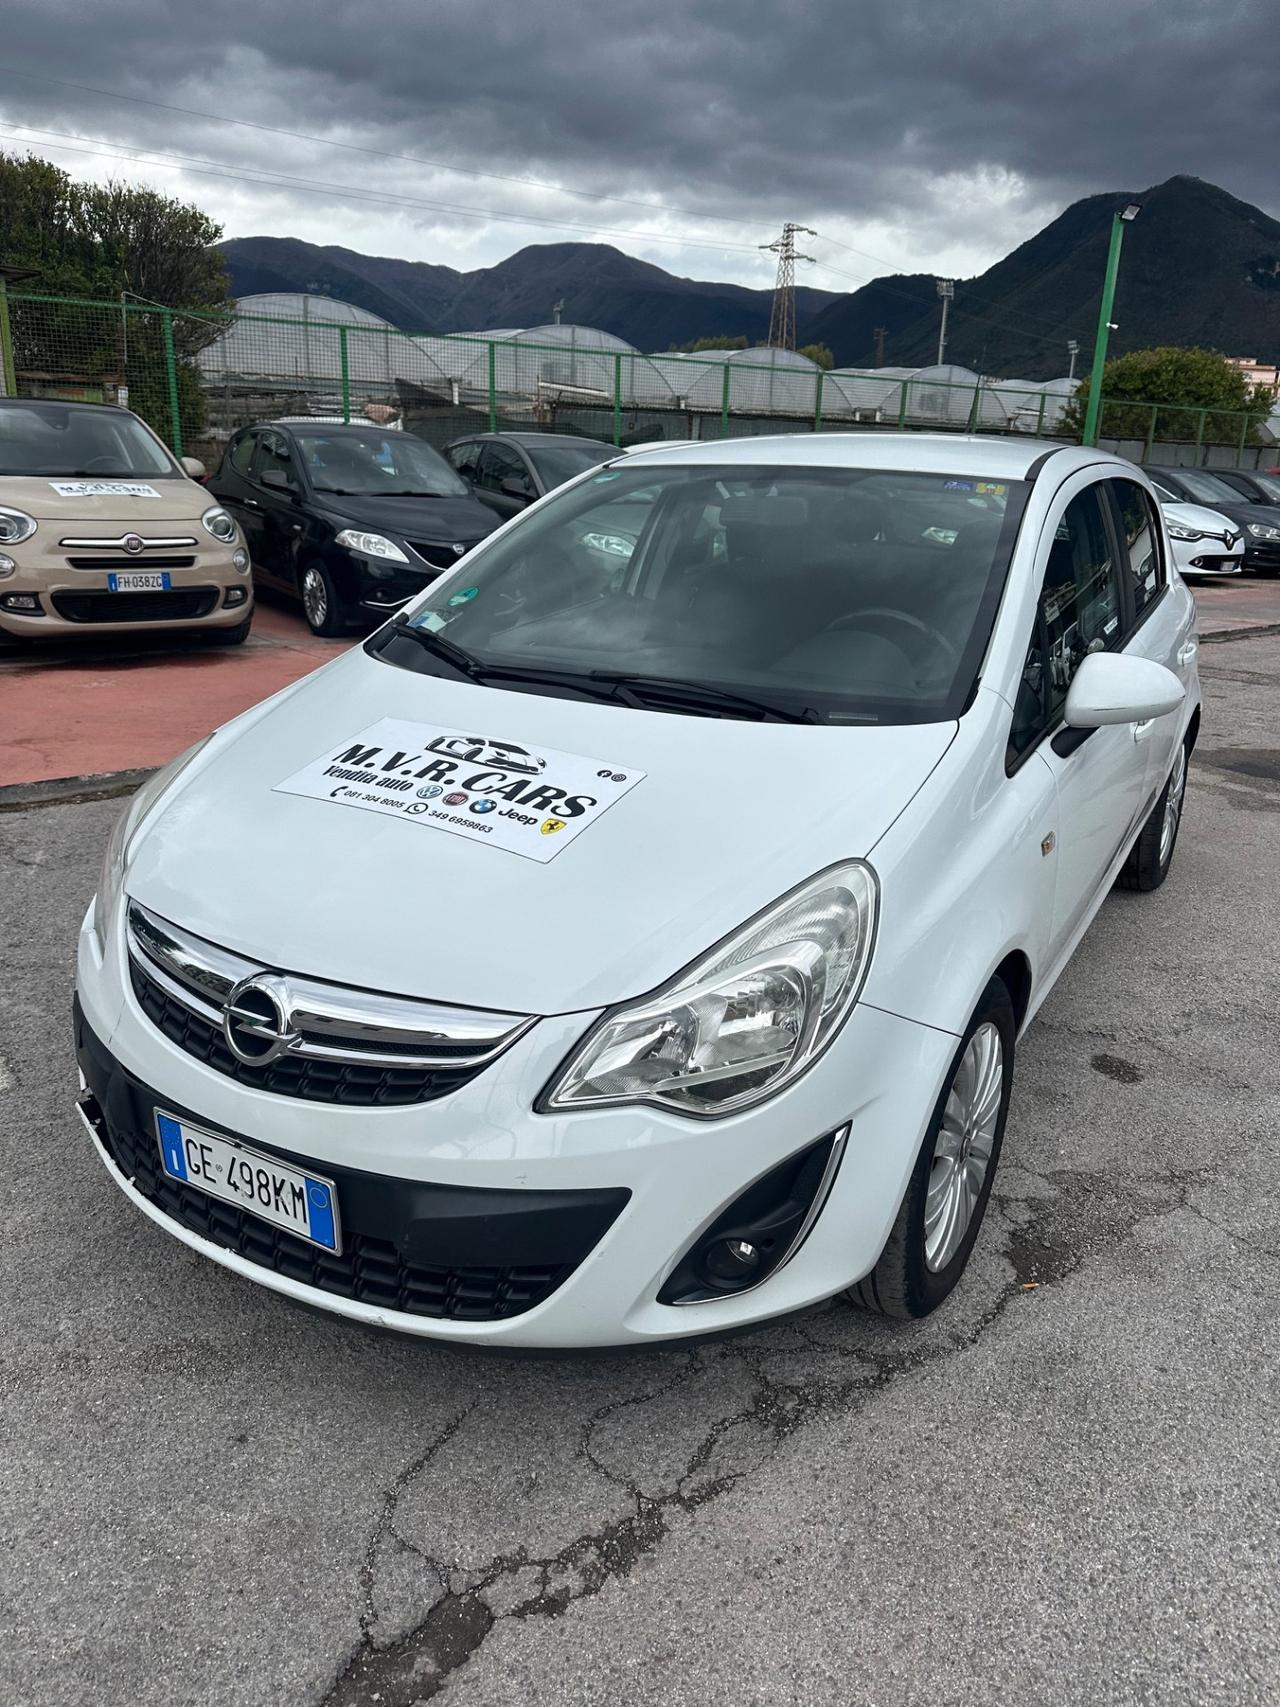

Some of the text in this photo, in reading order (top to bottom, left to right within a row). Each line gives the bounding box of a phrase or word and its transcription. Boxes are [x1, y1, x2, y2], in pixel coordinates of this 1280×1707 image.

[322, 765, 414, 792] Vendita auto
[343, 788, 406, 809] 081 304 8005
[428, 810, 494, 834] 349 6959863
[498, 808, 539, 826] Jeep
